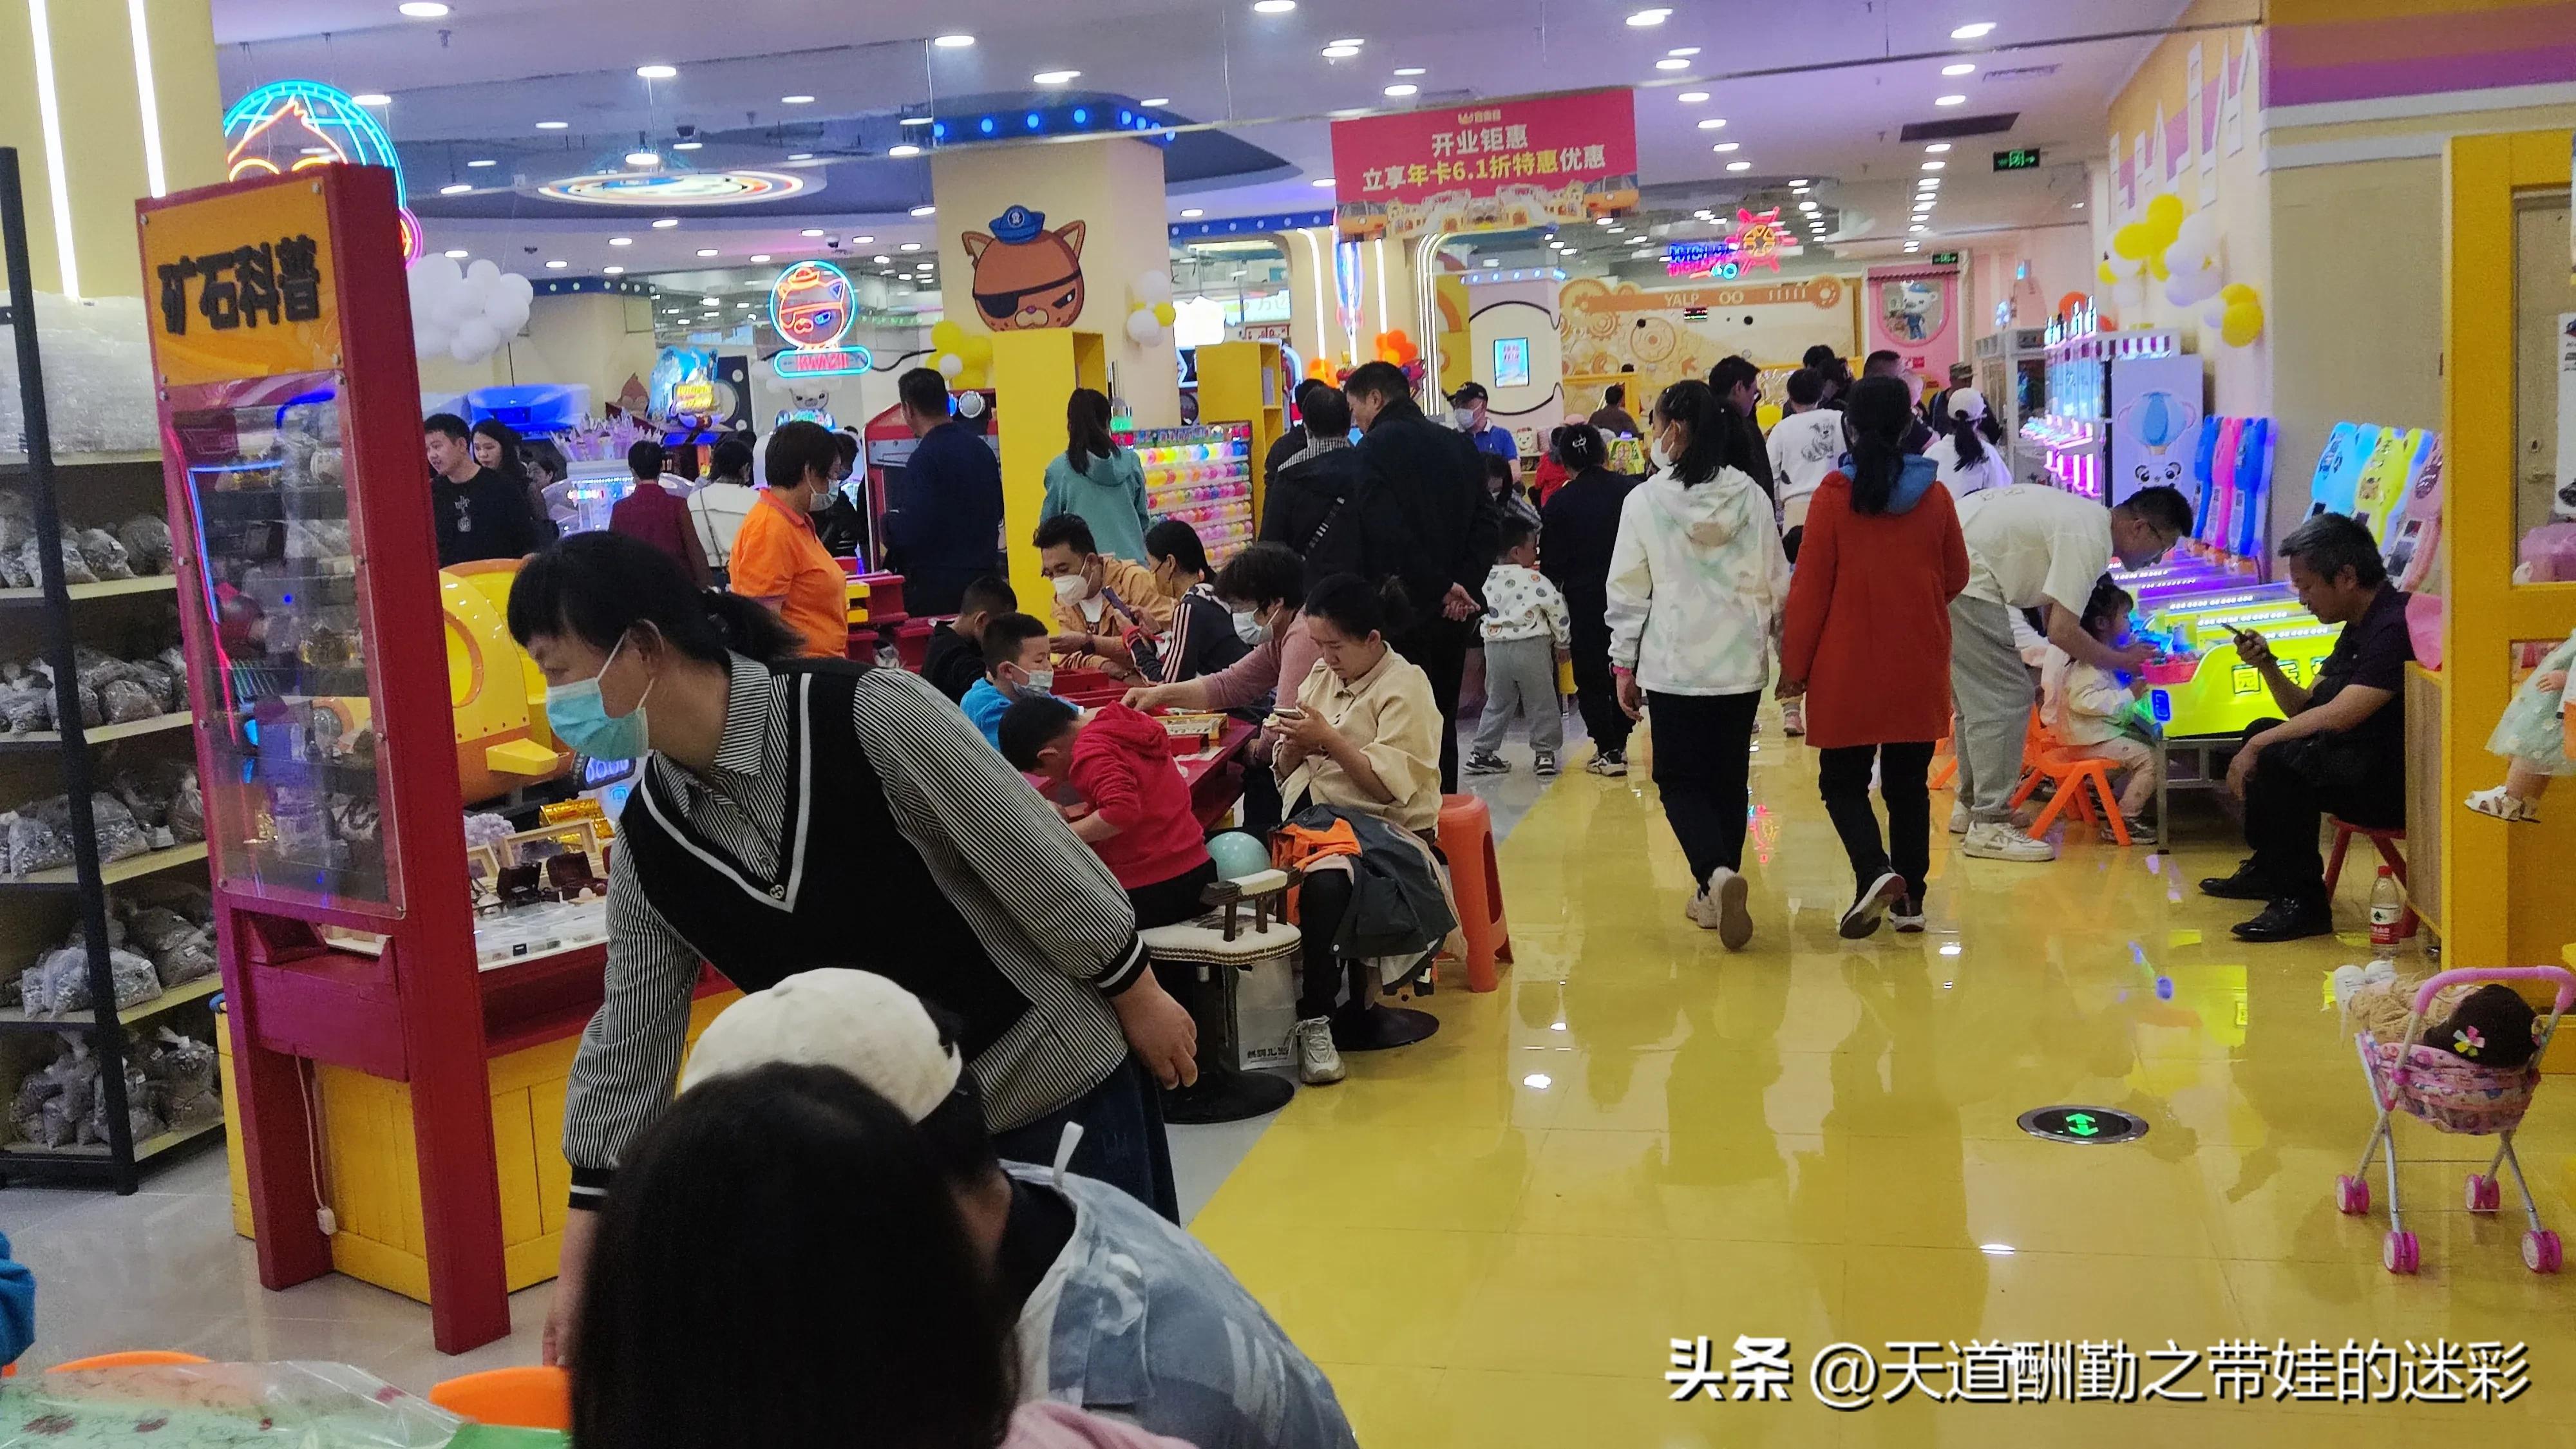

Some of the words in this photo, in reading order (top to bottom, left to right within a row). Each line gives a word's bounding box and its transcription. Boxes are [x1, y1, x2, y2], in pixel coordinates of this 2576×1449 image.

[1431, 124, 1528, 158] 开业钜惠
[1362, 144, 1606, 192] 立享年卡6.1折特惠优惠
[158, 234, 320, 336] 矿石科普
[1664, 293, 1700, 307] YALP
